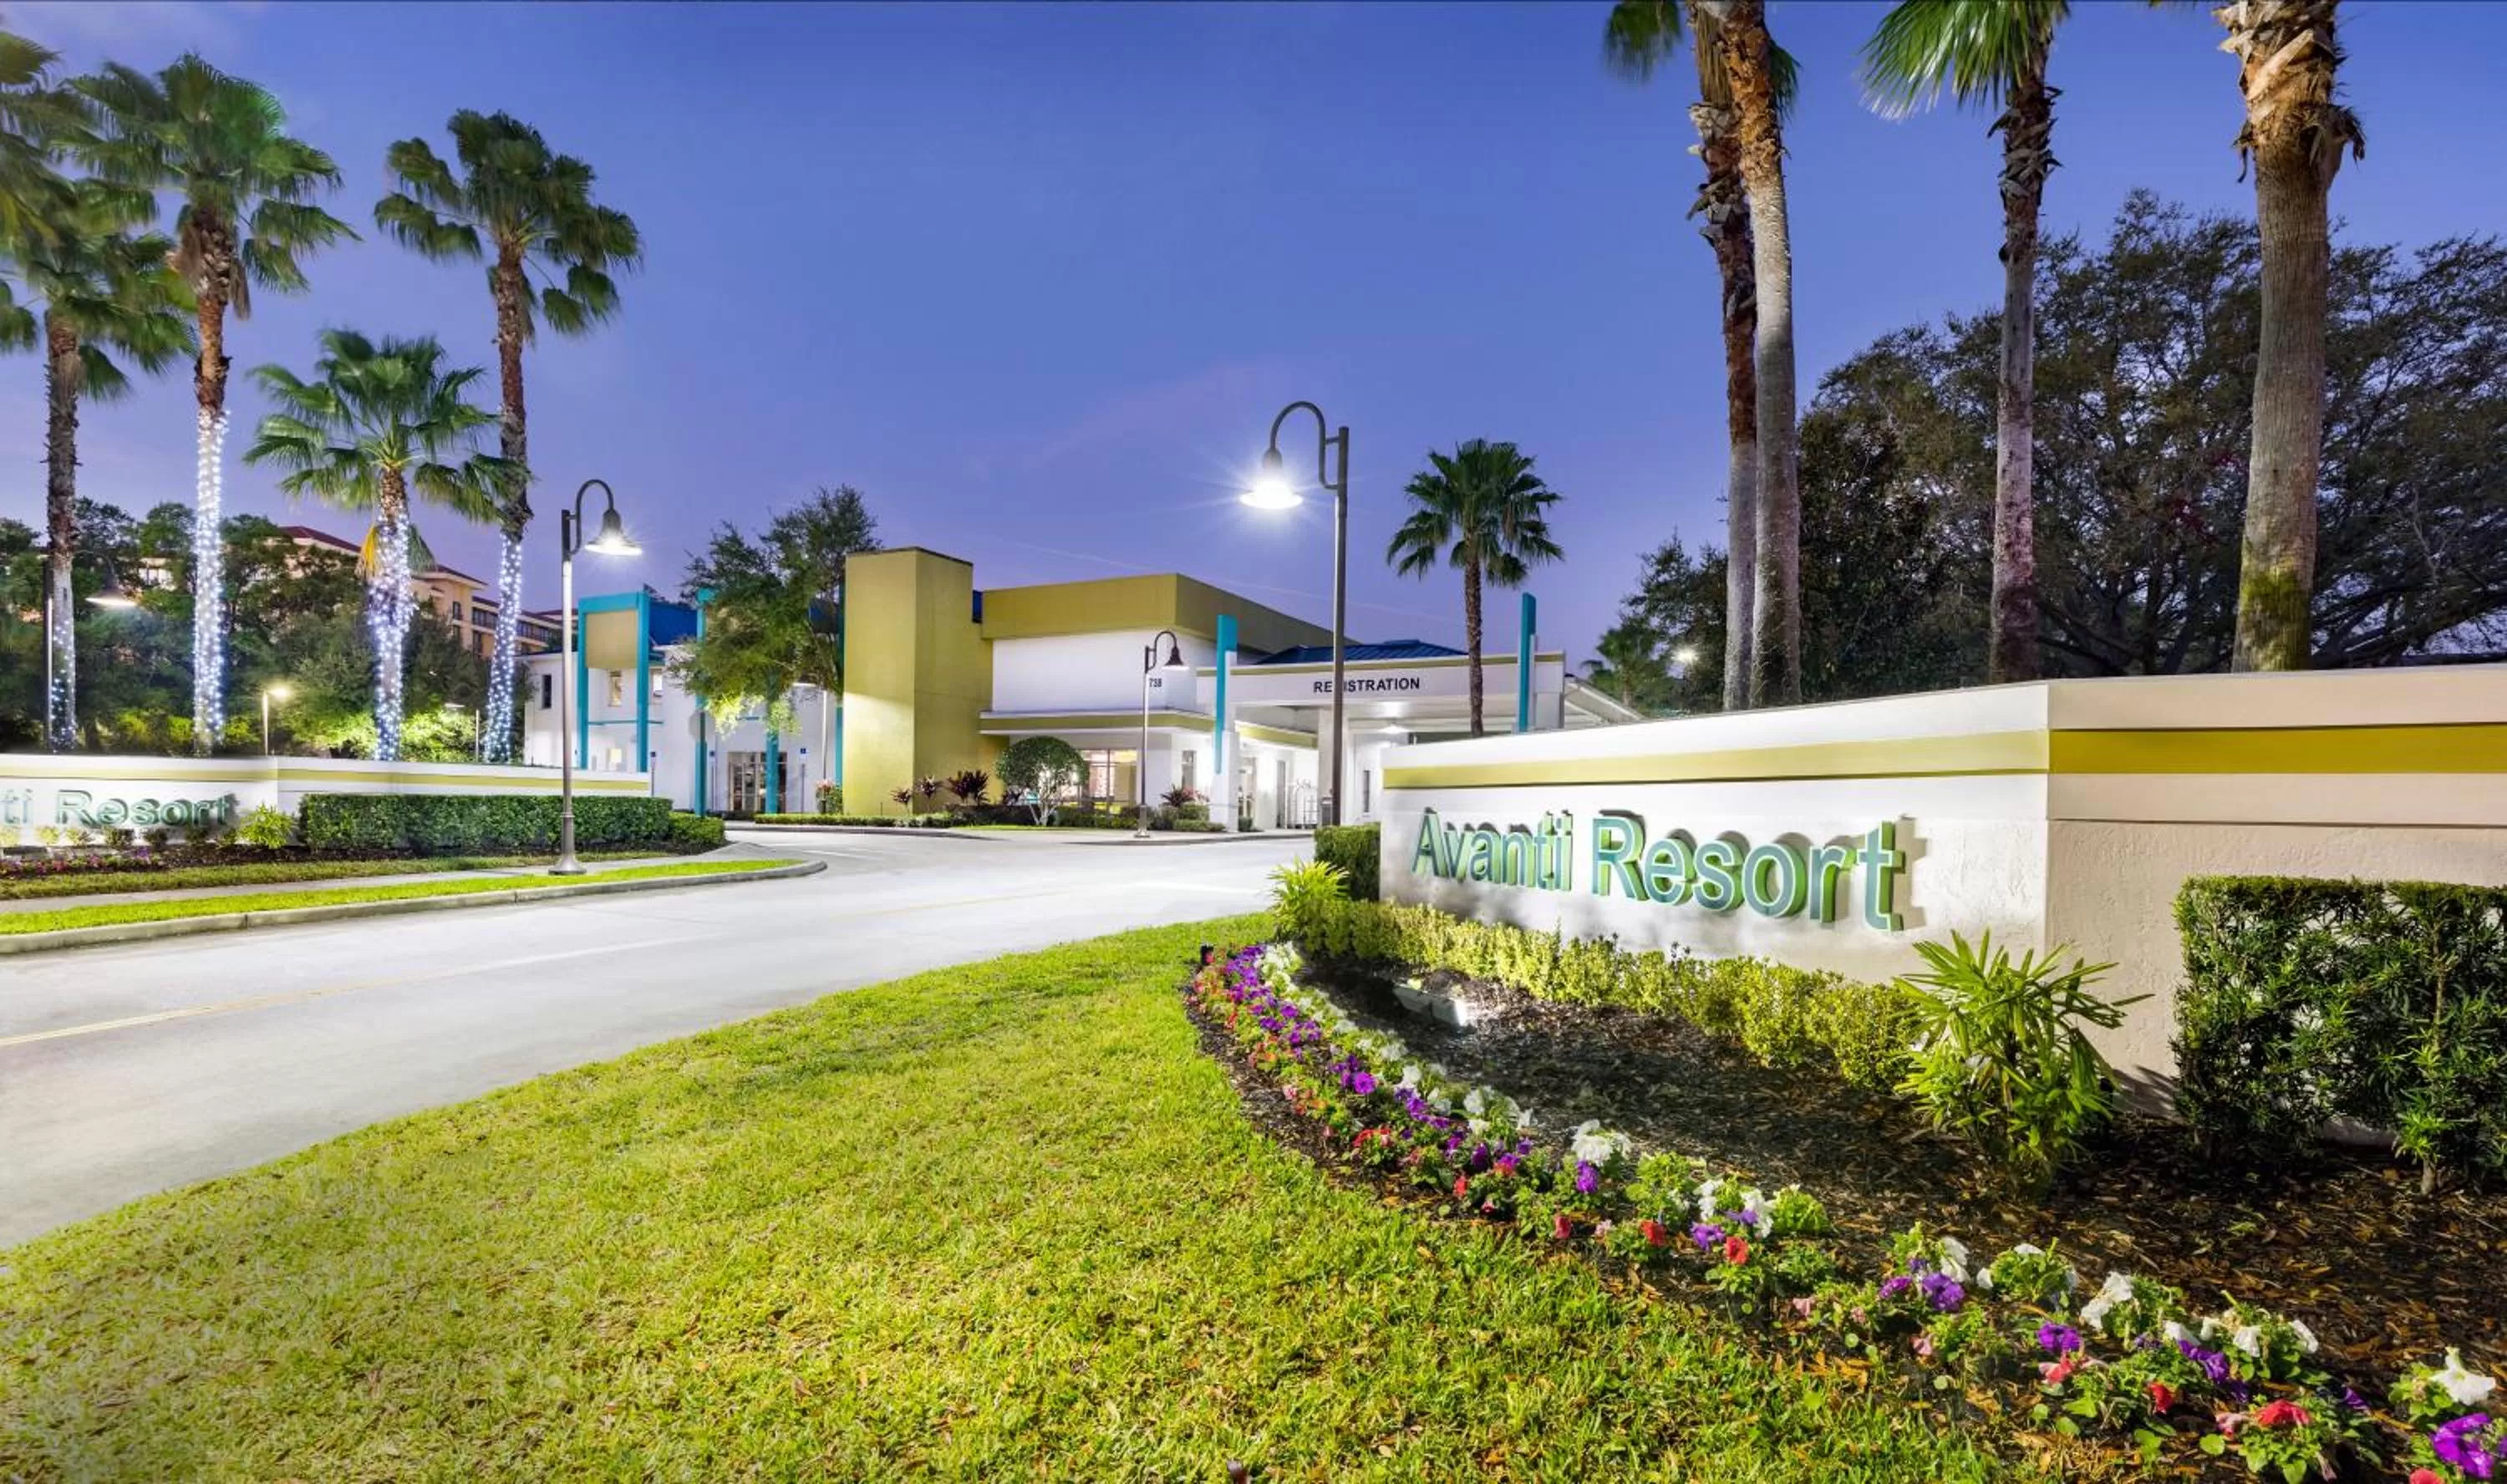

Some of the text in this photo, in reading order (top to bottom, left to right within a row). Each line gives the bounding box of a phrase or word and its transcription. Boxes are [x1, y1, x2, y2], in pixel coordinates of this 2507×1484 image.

[1313, 676, 1421, 693] REISTRATION
[55, 790, 231, 826] Resort
[1411, 808, 1904, 932] Avanti Resort
